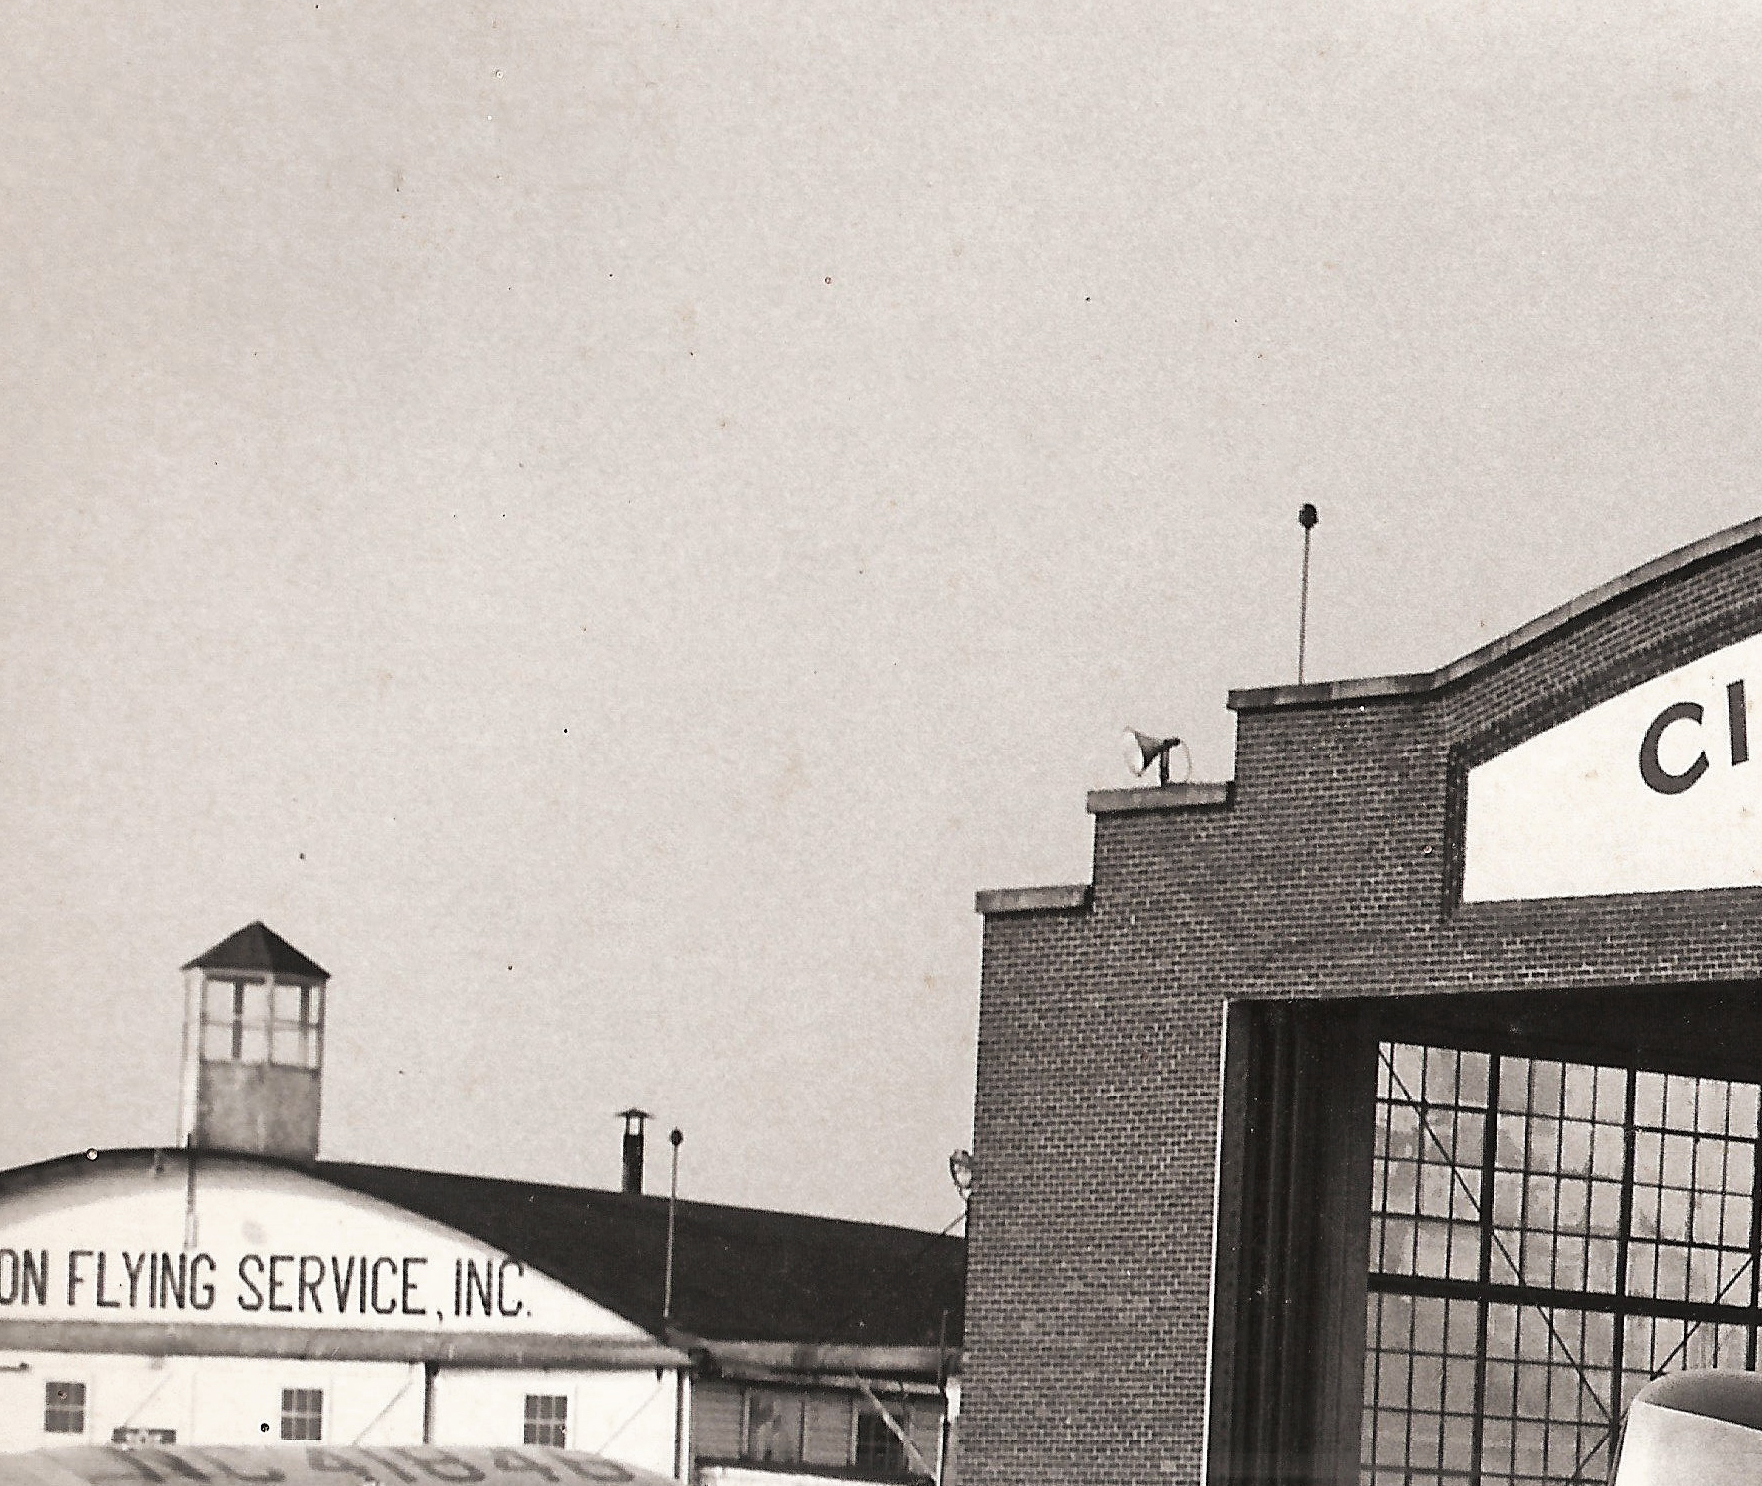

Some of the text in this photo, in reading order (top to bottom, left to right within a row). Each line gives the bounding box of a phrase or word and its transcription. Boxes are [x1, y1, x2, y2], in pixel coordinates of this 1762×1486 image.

[0, 1248, 49, 1307] ON
[68, 1250, 217, 1311] FLYING
[453, 1259, 533, 1318] INC.
